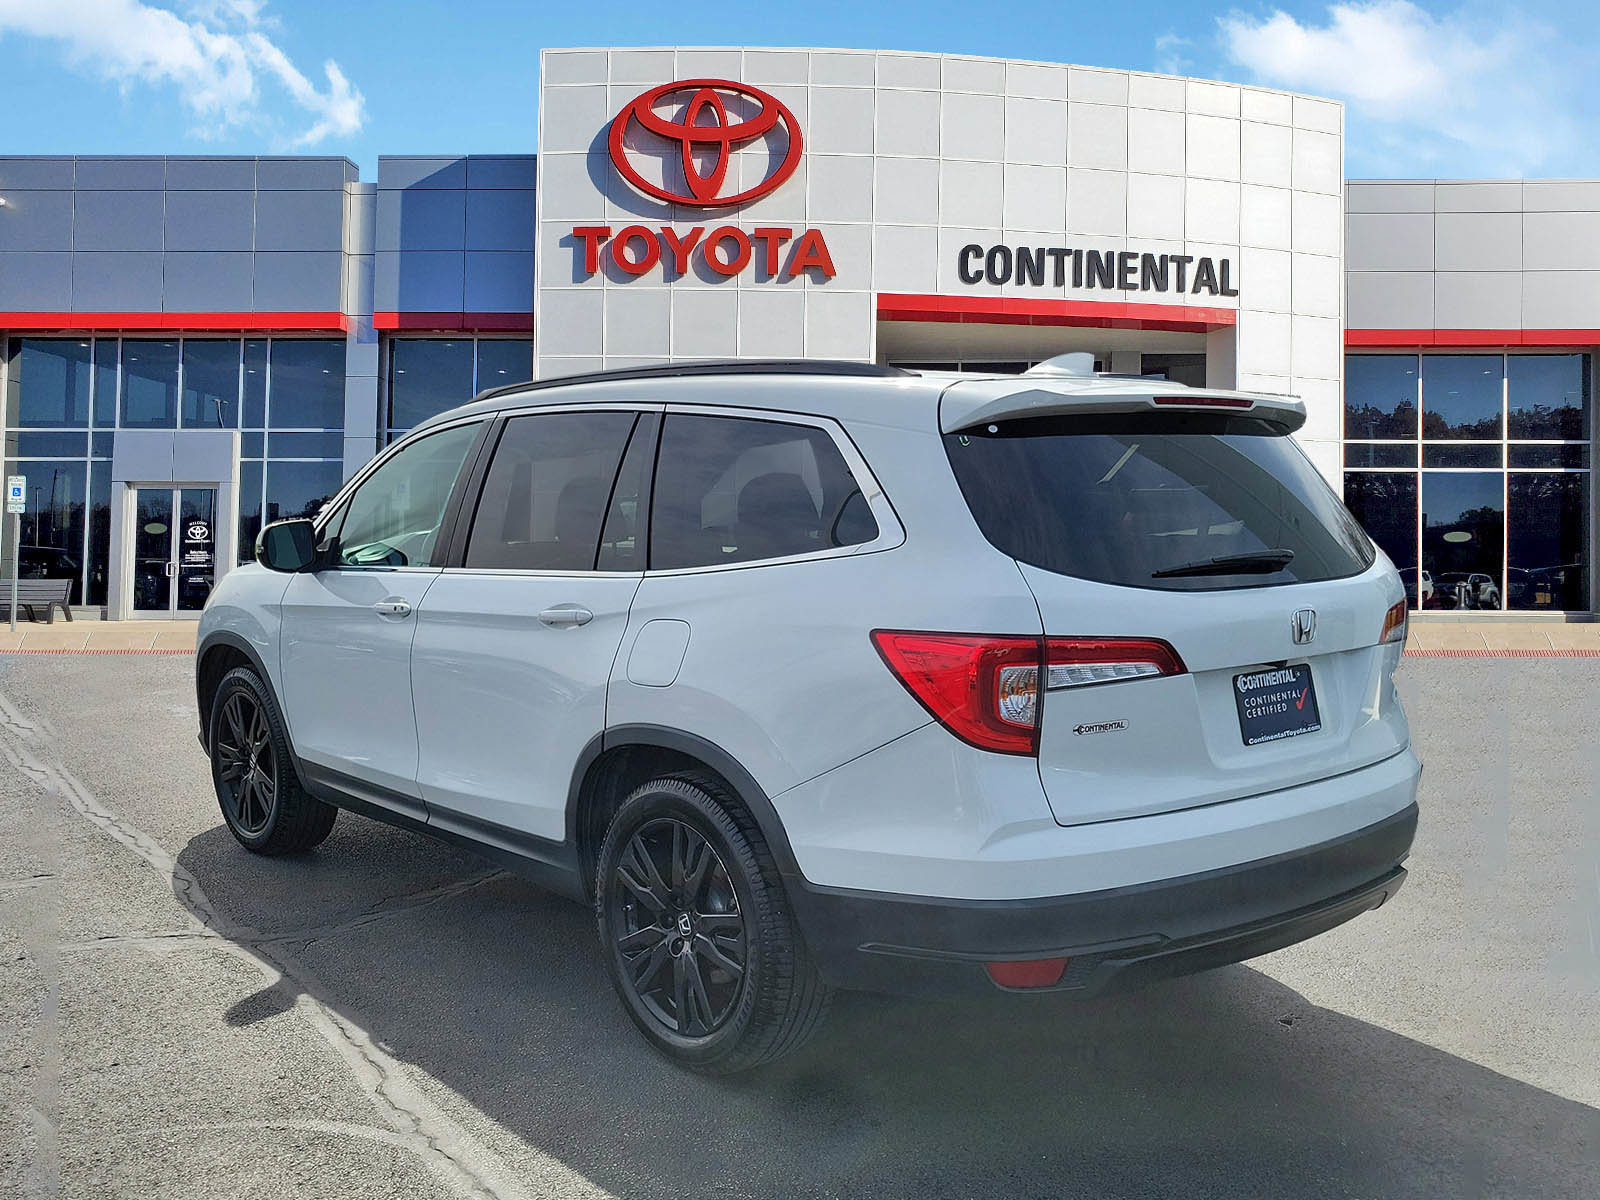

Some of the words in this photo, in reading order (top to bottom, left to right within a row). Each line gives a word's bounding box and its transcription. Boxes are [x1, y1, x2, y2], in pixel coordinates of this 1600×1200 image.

[573, 225, 837, 277] TOYOTA
[958, 243, 1239, 297] CONTINENTAL
[1238, 669, 1297, 692] CONTINENTAL
[1244, 689, 1301, 708] CONTINENTAL
[1246, 703, 1288, 719] CERTIFIED
[1078, 721, 1125, 735] CONTINENTAL
[1248, 725, 1320, 745] ContinentalToyota.com
